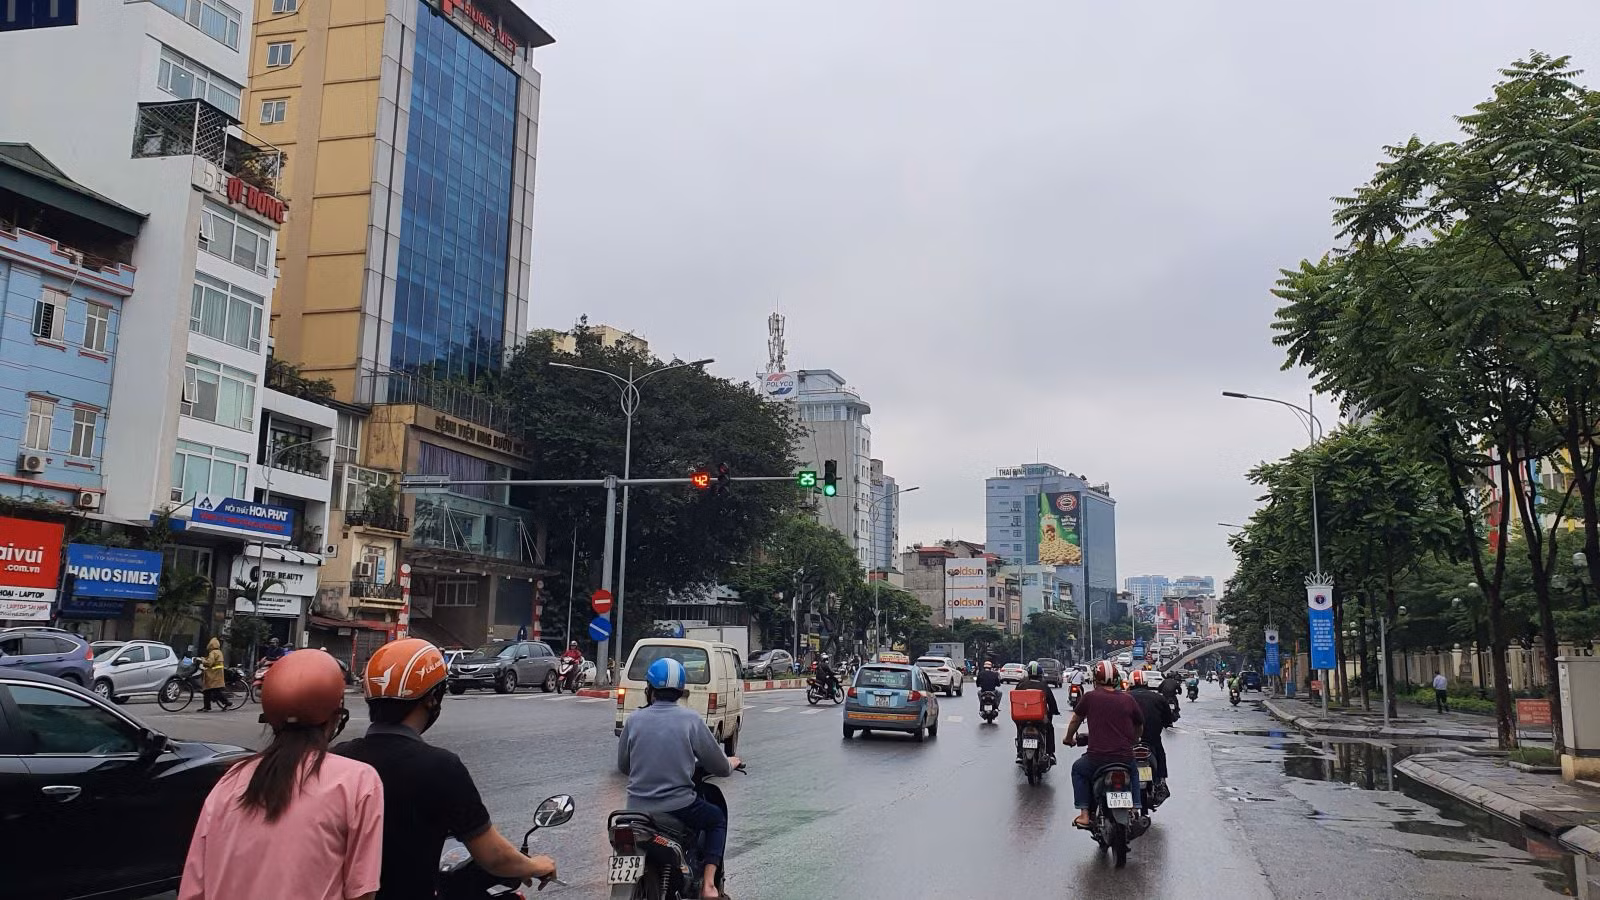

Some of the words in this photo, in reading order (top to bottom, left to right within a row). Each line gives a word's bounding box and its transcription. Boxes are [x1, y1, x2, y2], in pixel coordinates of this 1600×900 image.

[765, 380, 794, 388] POLYCO
[694, 475, 708, 486] 42
[800, 473, 815, 486] 25
[4, 564, 40, 574] .com.vn
[68, 565, 159, 586] HANOSIMEX
[262, 570, 276, 578] THE
[278, 571, 304, 581] BEAUTY
[19, 590, 45, 599] LAPTOP
[947, 597, 984, 608] goldsun
[611, 869, 637, 882] 4424
